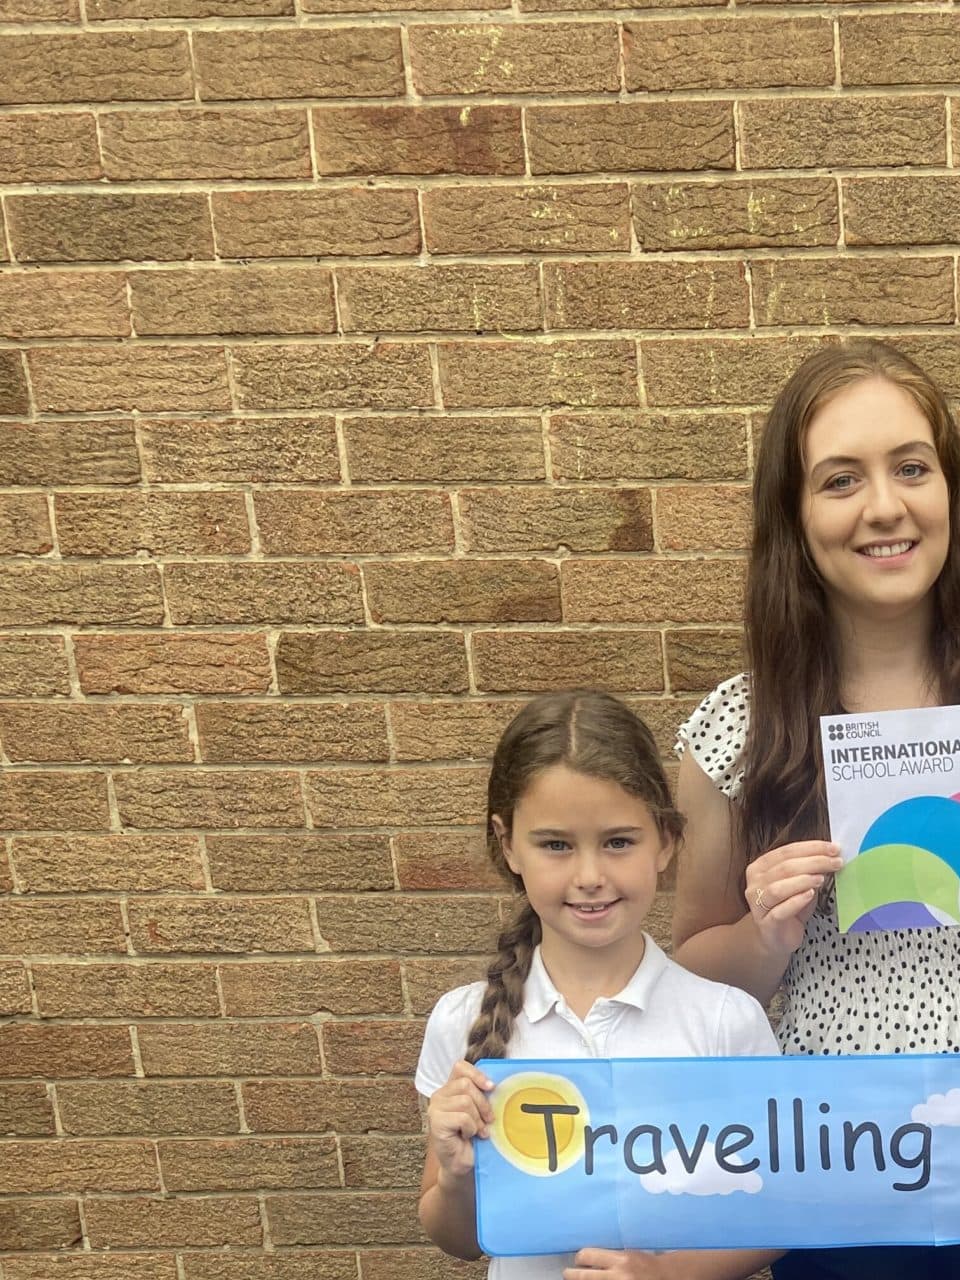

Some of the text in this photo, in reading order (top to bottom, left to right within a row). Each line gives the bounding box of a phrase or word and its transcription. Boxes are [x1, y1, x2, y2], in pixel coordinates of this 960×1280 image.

[845, 721, 879, 731] BRITISH
[845, 729, 882, 739] COUNCIL
[832, 757, 954, 781] SCHOOL AWARD
[520, 1097, 932, 1192] Travelling
